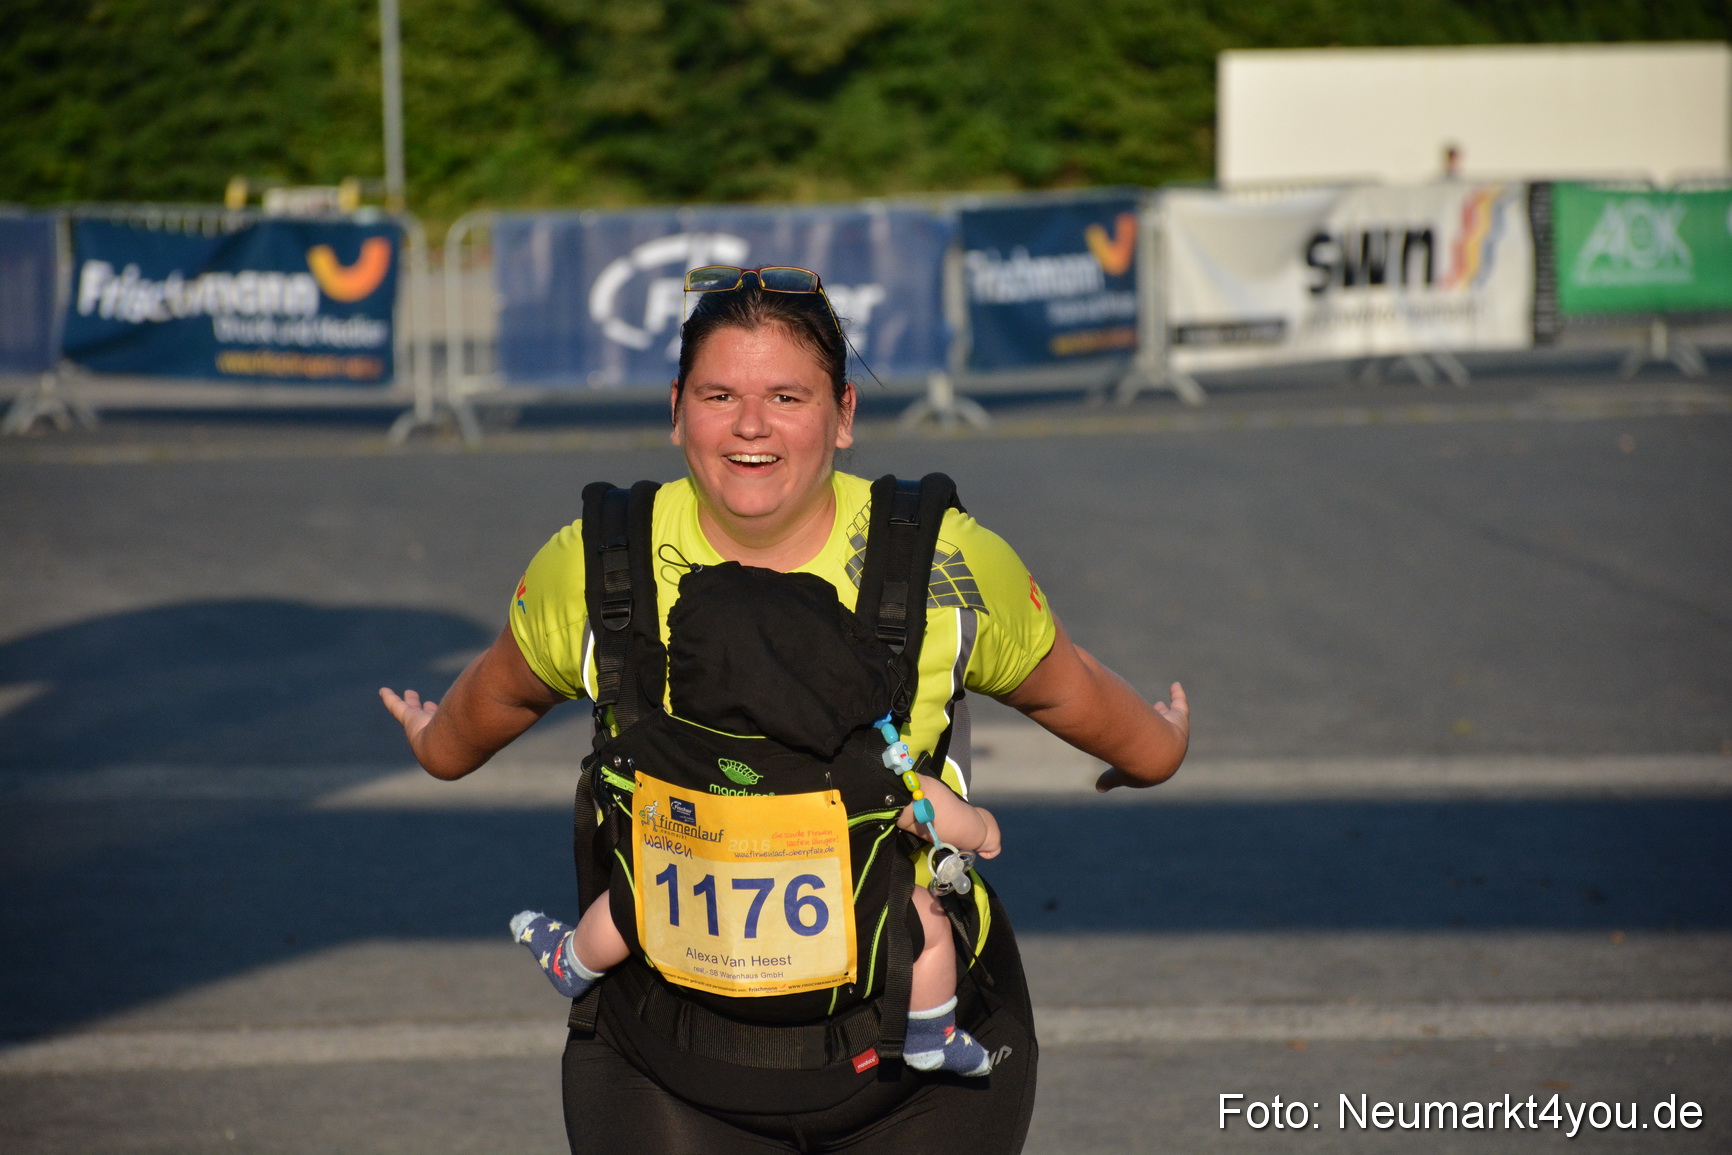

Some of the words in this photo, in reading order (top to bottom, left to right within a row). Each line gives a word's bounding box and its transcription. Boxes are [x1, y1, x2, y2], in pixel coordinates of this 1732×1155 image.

[660, 815, 724, 842] firmenlauf
[644, 834, 693, 859] walken
[728, 839, 771, 852] 2016
[656, 863, 830, 939] 1176
[685, 947, 718, 964] Alexa
[720, 954, 746, 968] Van
[751, 955, 792, 967] Heest
[710, 968, 719, 977] SB
[720, 970, 758, 980] Warenhaus
[760, 971, 784, 979] GmbH
